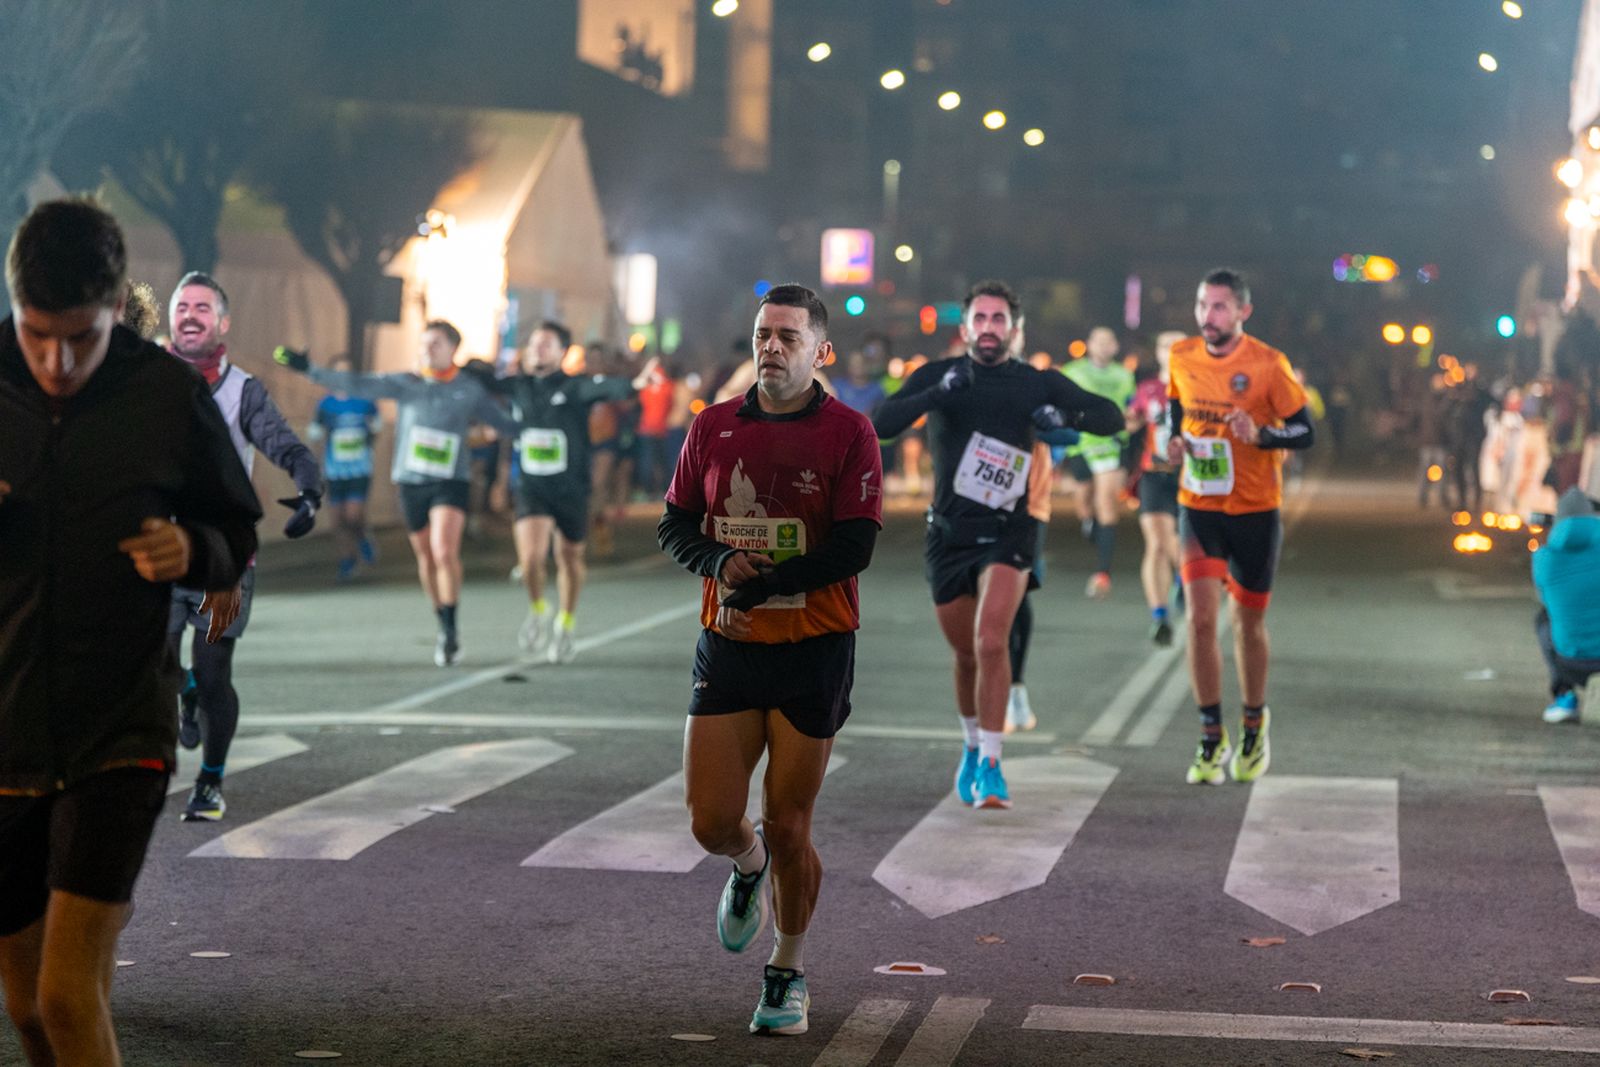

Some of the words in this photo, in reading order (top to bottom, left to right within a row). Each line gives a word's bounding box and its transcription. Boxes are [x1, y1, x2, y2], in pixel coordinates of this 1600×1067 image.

[974, 459, 1015, 490] 7563
[729, 527, 756, 537] NOCHE
[757, 528, 768, 537] DE
[738, 536, 768, 549] ANTÓN
